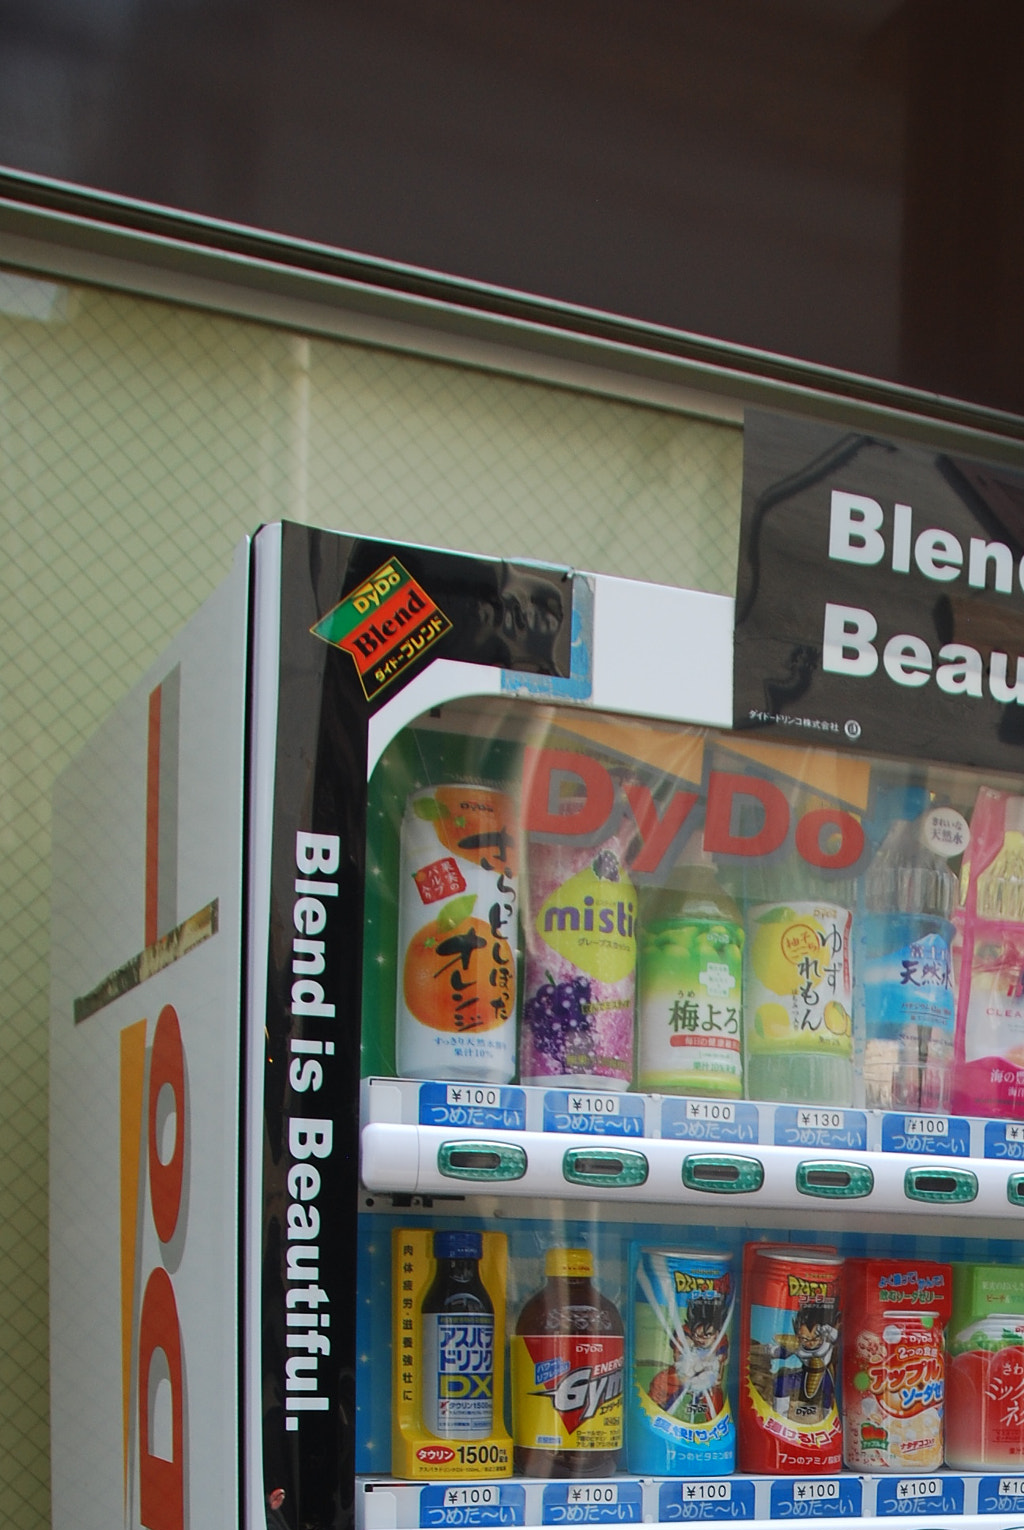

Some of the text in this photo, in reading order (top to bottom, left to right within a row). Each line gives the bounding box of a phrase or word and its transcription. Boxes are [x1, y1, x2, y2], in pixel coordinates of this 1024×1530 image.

[352, 566, 401, 615] DyDo
[352, 587, 427, 657] Blend
[374, 615, 445, 683] ダイドーブレンド
[749, 710, 839, 731] ダイドードリンコ株式会社
[523, 744, 868, 874] DyDo
[931, 829, 963, 845] 天然水
[821, 924, 842, 994] ゆず
[434, 927, 487, 1031] オレンジ
[798, 956, 822, 1031] れもん
[452, 1089, 496, 1104] ¥100
[572, 1098, 615, 1113] ¥100
[690, 1104, 731, 1121] ¥100
[802, 1113, 840, 1127] ¥130
[285, 831, 341, 1431] Blend is Beautiful.
[439, 1350, 493, 1371] ドリンク
[868, 1361, 941, 1392] アップル
[440, 1375, 492, 1399] DX
[796, 1406, 817, 1416] DyDo
[417, 1446, 498, 1464] タウリン 1500
[449, 1489, 492, 1504] ¥100
[572, 1488, 613, 1502] ¥100
[686, 1485, 727, 1499] ¥100
[797, 1483, 836, 1499] ¥100
[900, 1480, 937, 1497] ¥100
